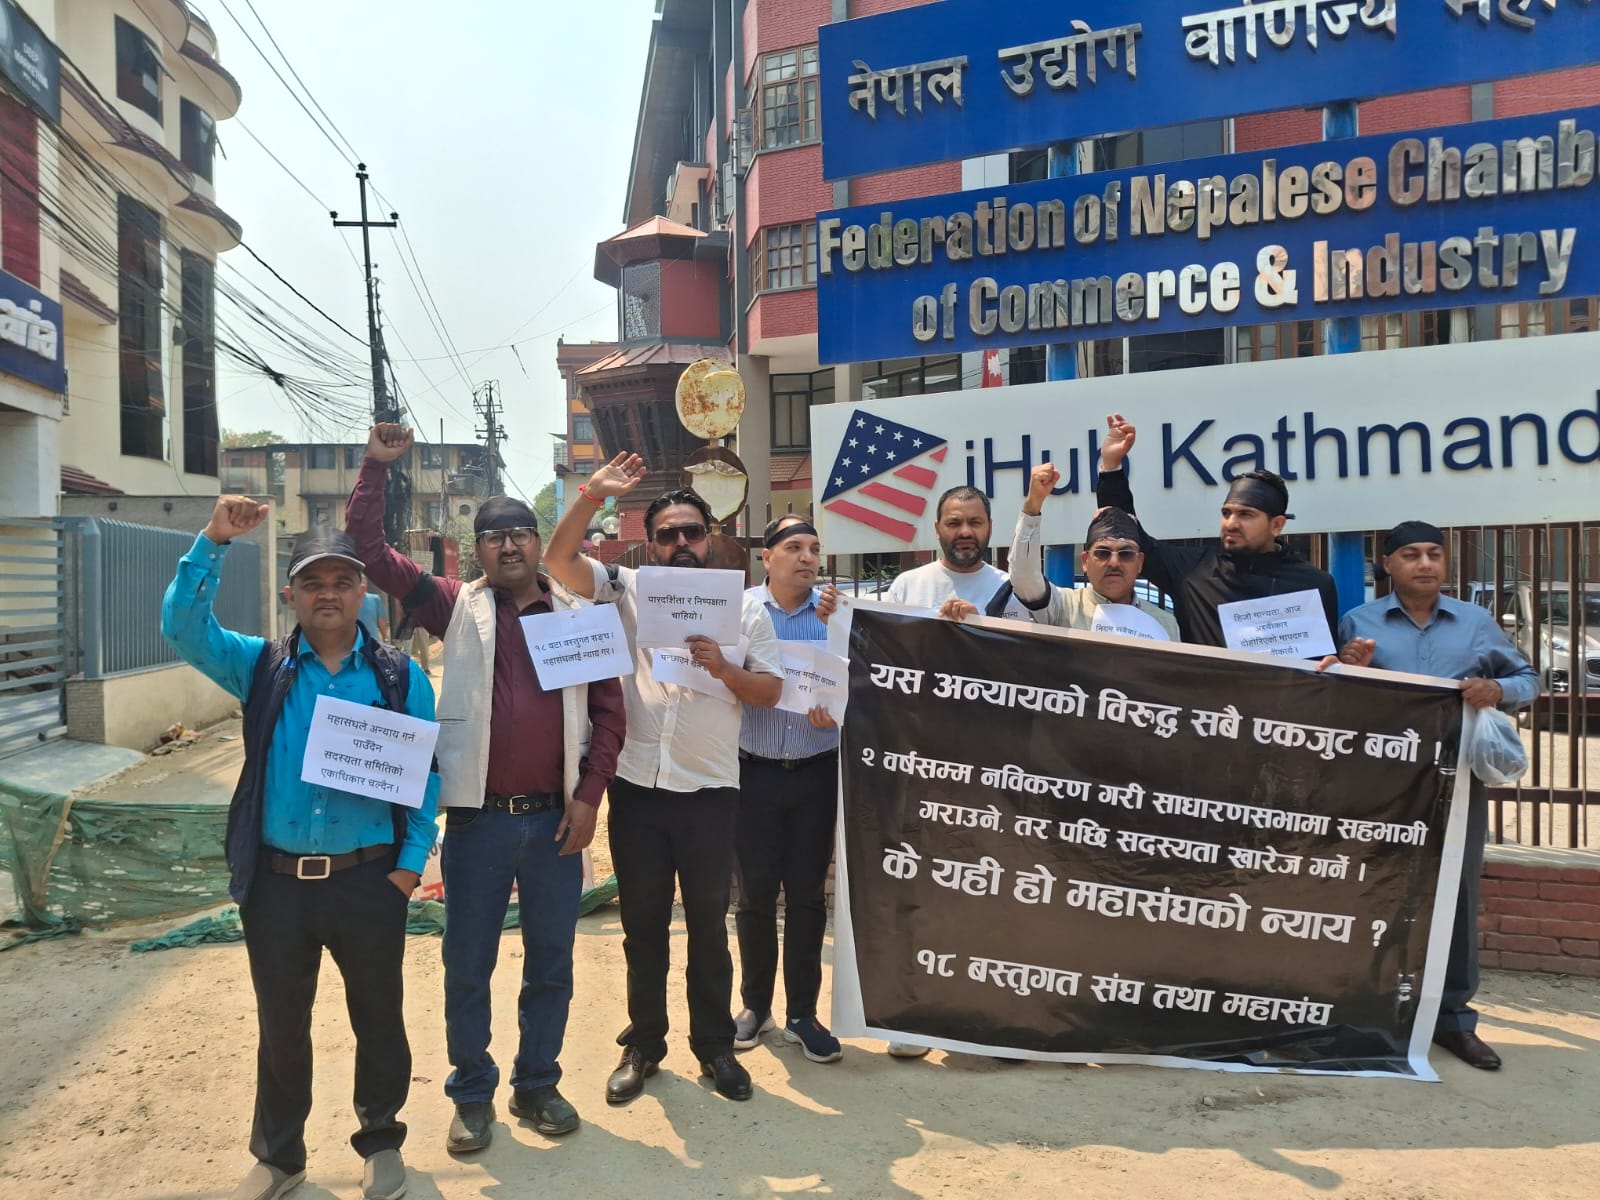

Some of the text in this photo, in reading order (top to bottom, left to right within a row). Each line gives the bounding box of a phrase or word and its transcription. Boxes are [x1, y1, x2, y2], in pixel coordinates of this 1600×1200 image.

[848, 59, 968, 119] नेपाल
[998, 19, 1142, 95] उद्योग
[819, 118, 1600, 275] Federation of Nepalese Chamb
[912, 226, 1577, 343] of Commerce & Industry
[1162, 389, 1600, 489] Kathmand
[327, 713, 368, 731] महासंघले
[370, 724, 401, 739] अन्याय
[870, 663, 925, 694] यस
[933, 672, 1089, 718] अन्यायको
[1191, 704, 1243, 740] सबै
[1253, 717, 1358, 760] एकजुट
[321, 767, 366, 786] एकाधिकार
[324, 750, 404, 776] सदस्यता समितिको
[861, 747, 1429, 846] २ वर्षसम्म नविकरण गरी साधारणसभामा सहभागी
[883, 842, 1388, 947] के यही हो महासंघको न्याय ?
[1014, 815, 1052, 840] तर
[1059, 818, 1110, 848] पछि
[1117, 830, 1221, 864] सदस्यता
[1228, 845, 1303, 875] खारेज
[1309, 854, 1350, 880] गर्ने
[917, 949, 1334, 1026] १८ बस्तुगत संघ तथा महासंघ
